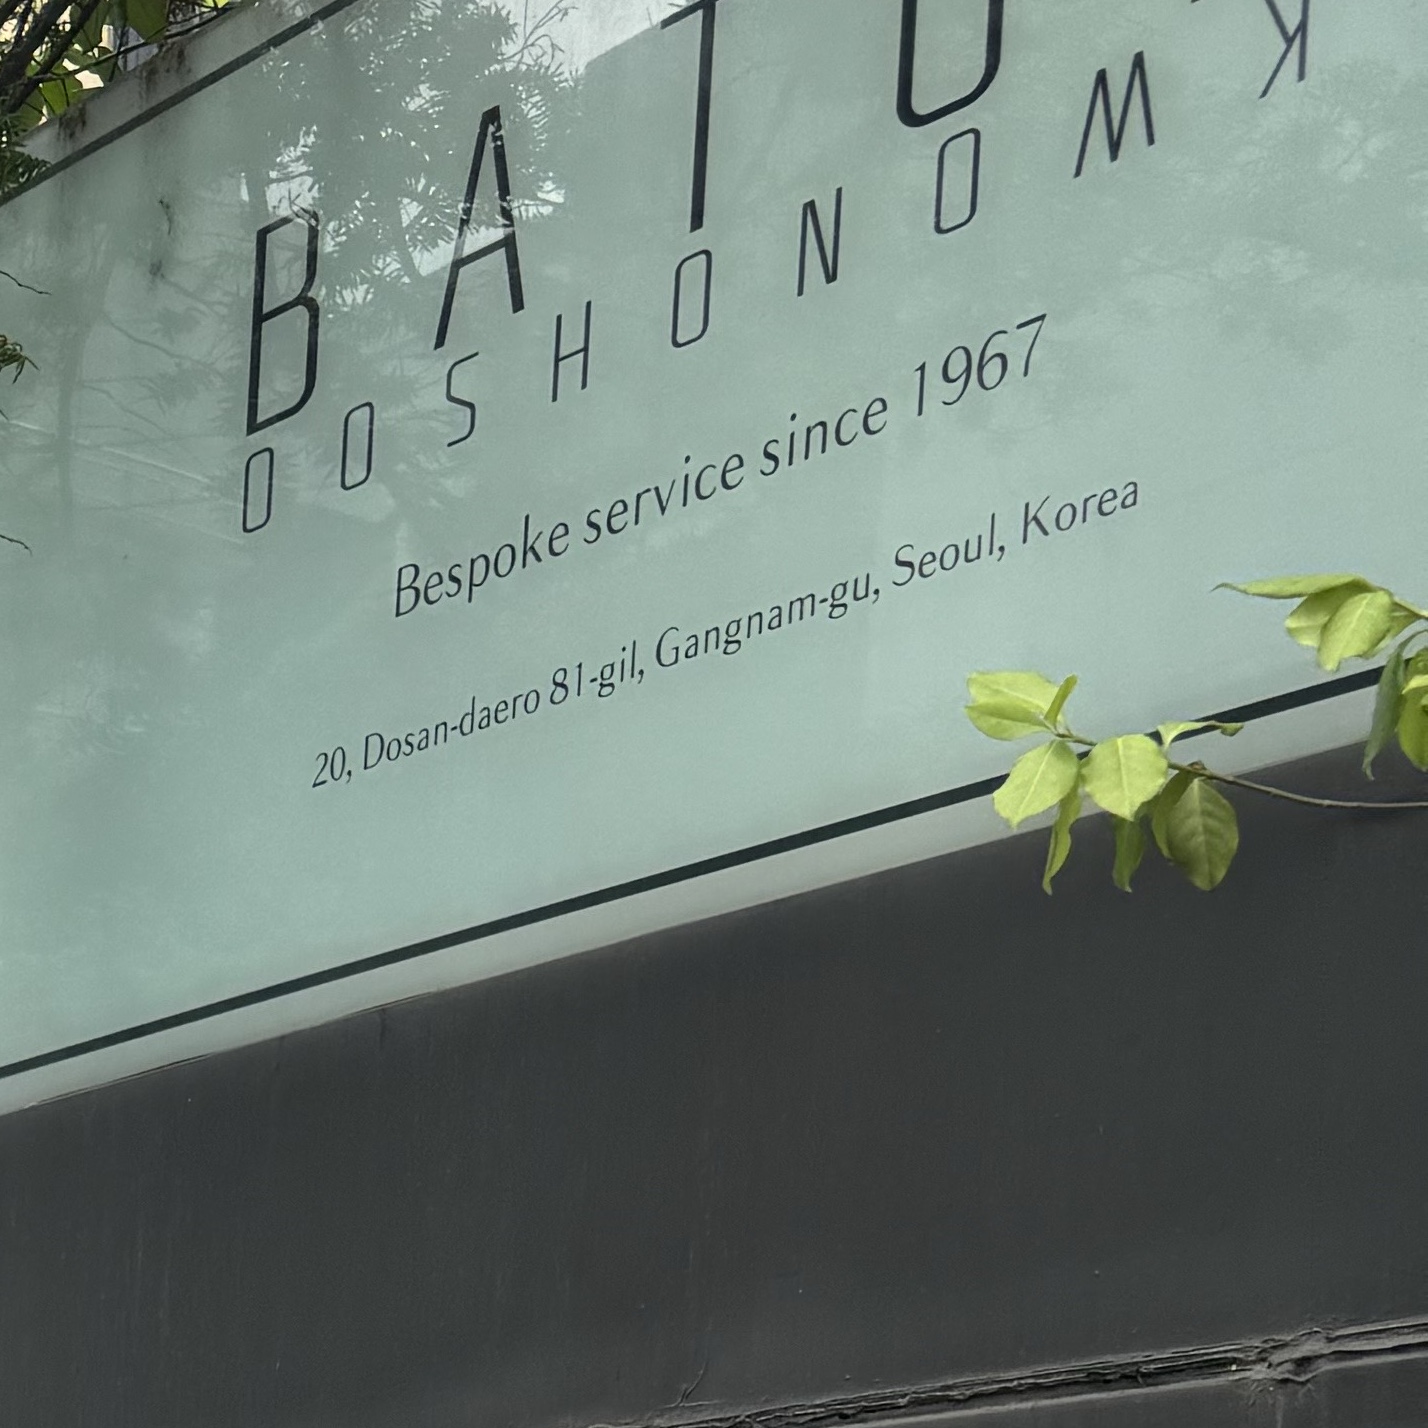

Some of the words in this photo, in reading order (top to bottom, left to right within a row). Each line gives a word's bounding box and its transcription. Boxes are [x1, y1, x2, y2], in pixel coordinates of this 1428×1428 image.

[394, 514, 570, 618] Bespoke
[583, 453, 744, 544] service
[759, 397, 888, 477] since
[913, 313, 1047, 418] 1967
[312, 746, 352, 788] 20,
[363, 695, 540, 770] Dosan-daero
[549, 640, 644, 705] 81-gil,
[655, 572, 880, 668] Gangnam-gu,
[892, 512, 1006, 587] Seoul,
[1022, 481, 1139, 545] Korea
